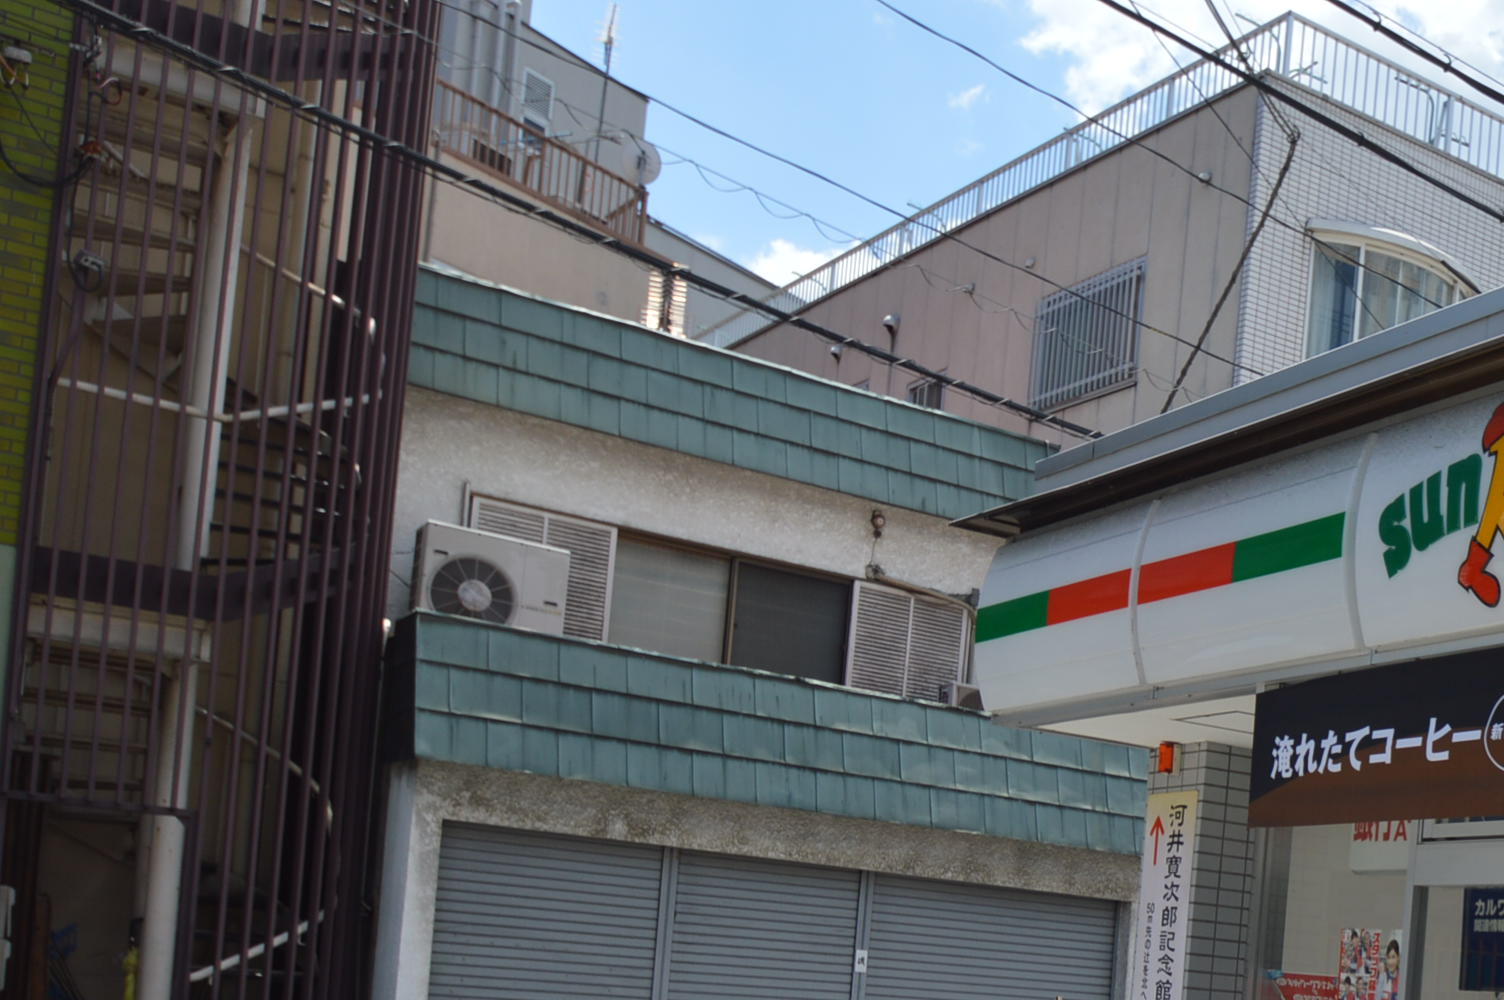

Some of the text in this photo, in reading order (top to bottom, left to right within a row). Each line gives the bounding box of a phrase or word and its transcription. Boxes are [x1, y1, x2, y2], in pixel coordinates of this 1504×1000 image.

[1270, 717, 1482, 780] 淹れたてコーヒー
[1353, 820, 1411, 841] 銀行A
